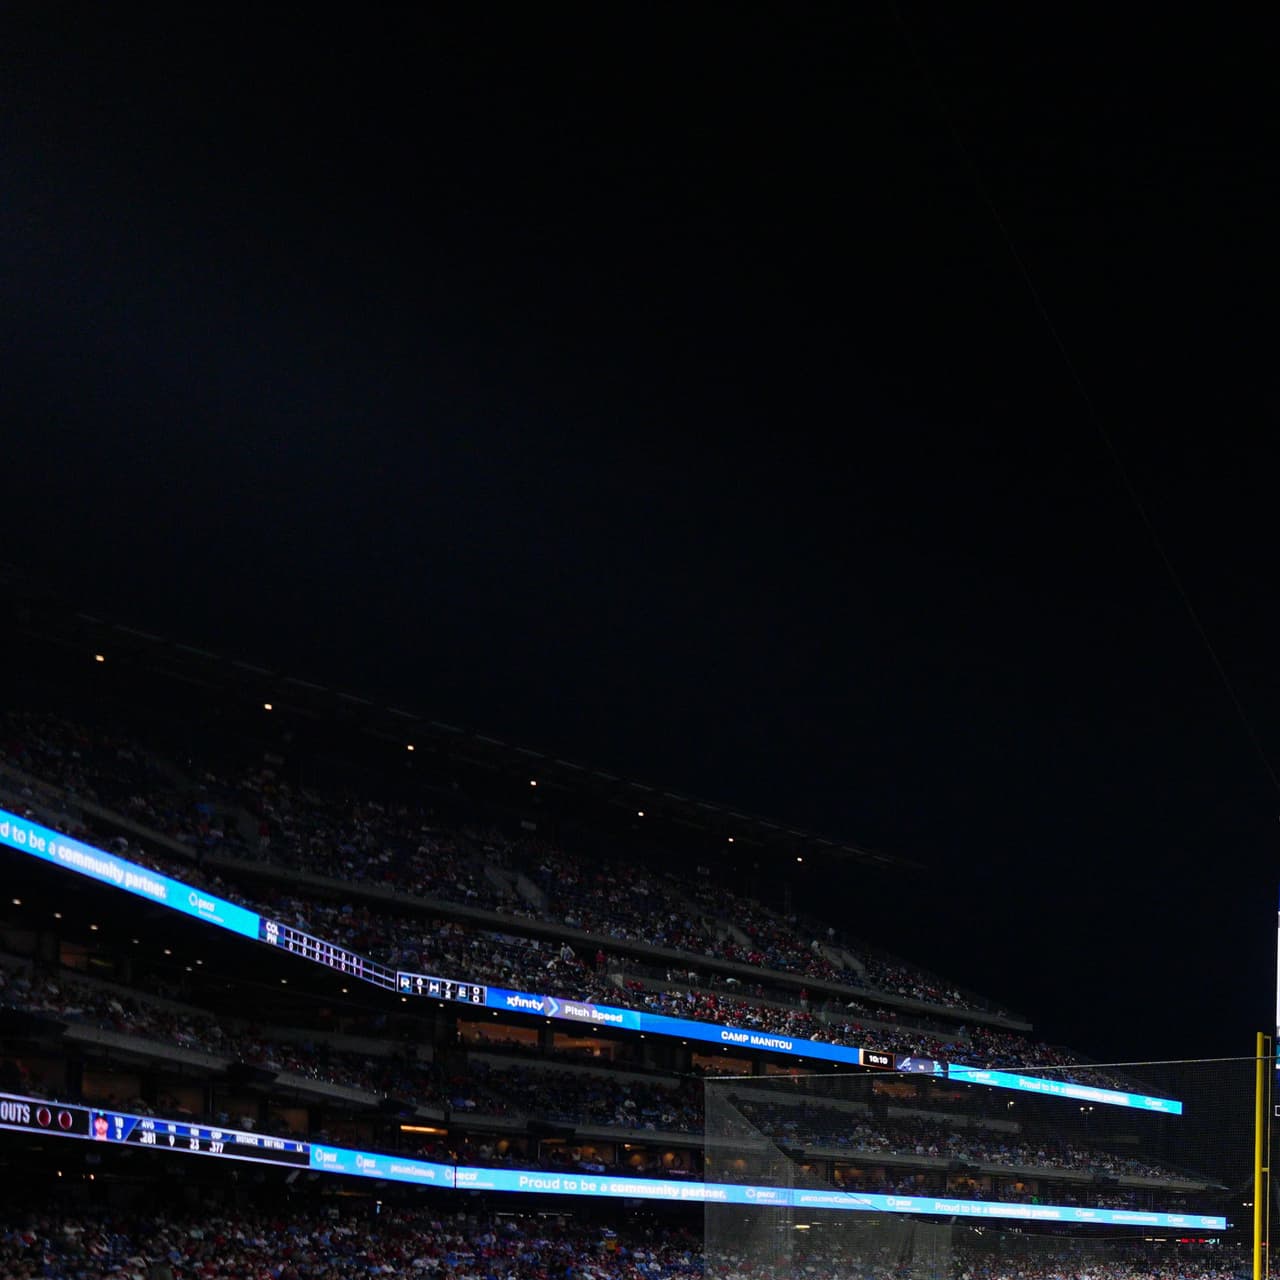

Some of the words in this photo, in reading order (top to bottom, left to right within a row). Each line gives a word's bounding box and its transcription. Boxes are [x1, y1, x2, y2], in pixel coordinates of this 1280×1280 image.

[13, 827, 27, 843] to
[29, 831, 46, 851] be
[58, 847, 125, 884] community
[125, 871, 167, 898] partner.
[265, 920, 279, 935] COL
[400, 976, 410, 989] R
[429, 981, 439, 994] H
[458, 986, 467, 999] E
[505, 994, 545, 1012] xfinity
[564, 1004, 590, 1019] Pitch
[591, 1008, 623, 1024] Speed
[721, 1030, 749, 1044] CAMP
[751, 1034, 793, 1051] MANITOU
[0, 1102, 31, 1125] OUTS
[190, 1138, 200, 1150] 23
[236, 1134, 259, 1147] DISTANCE
[519, 1175, 560, 1190] Proud
[563, 1180, 578, 1191] to
[580, 1178, 597, 1192] be
[610, 1183, 680, 1201] community
[681, 1186, 728, 1203] partner.
